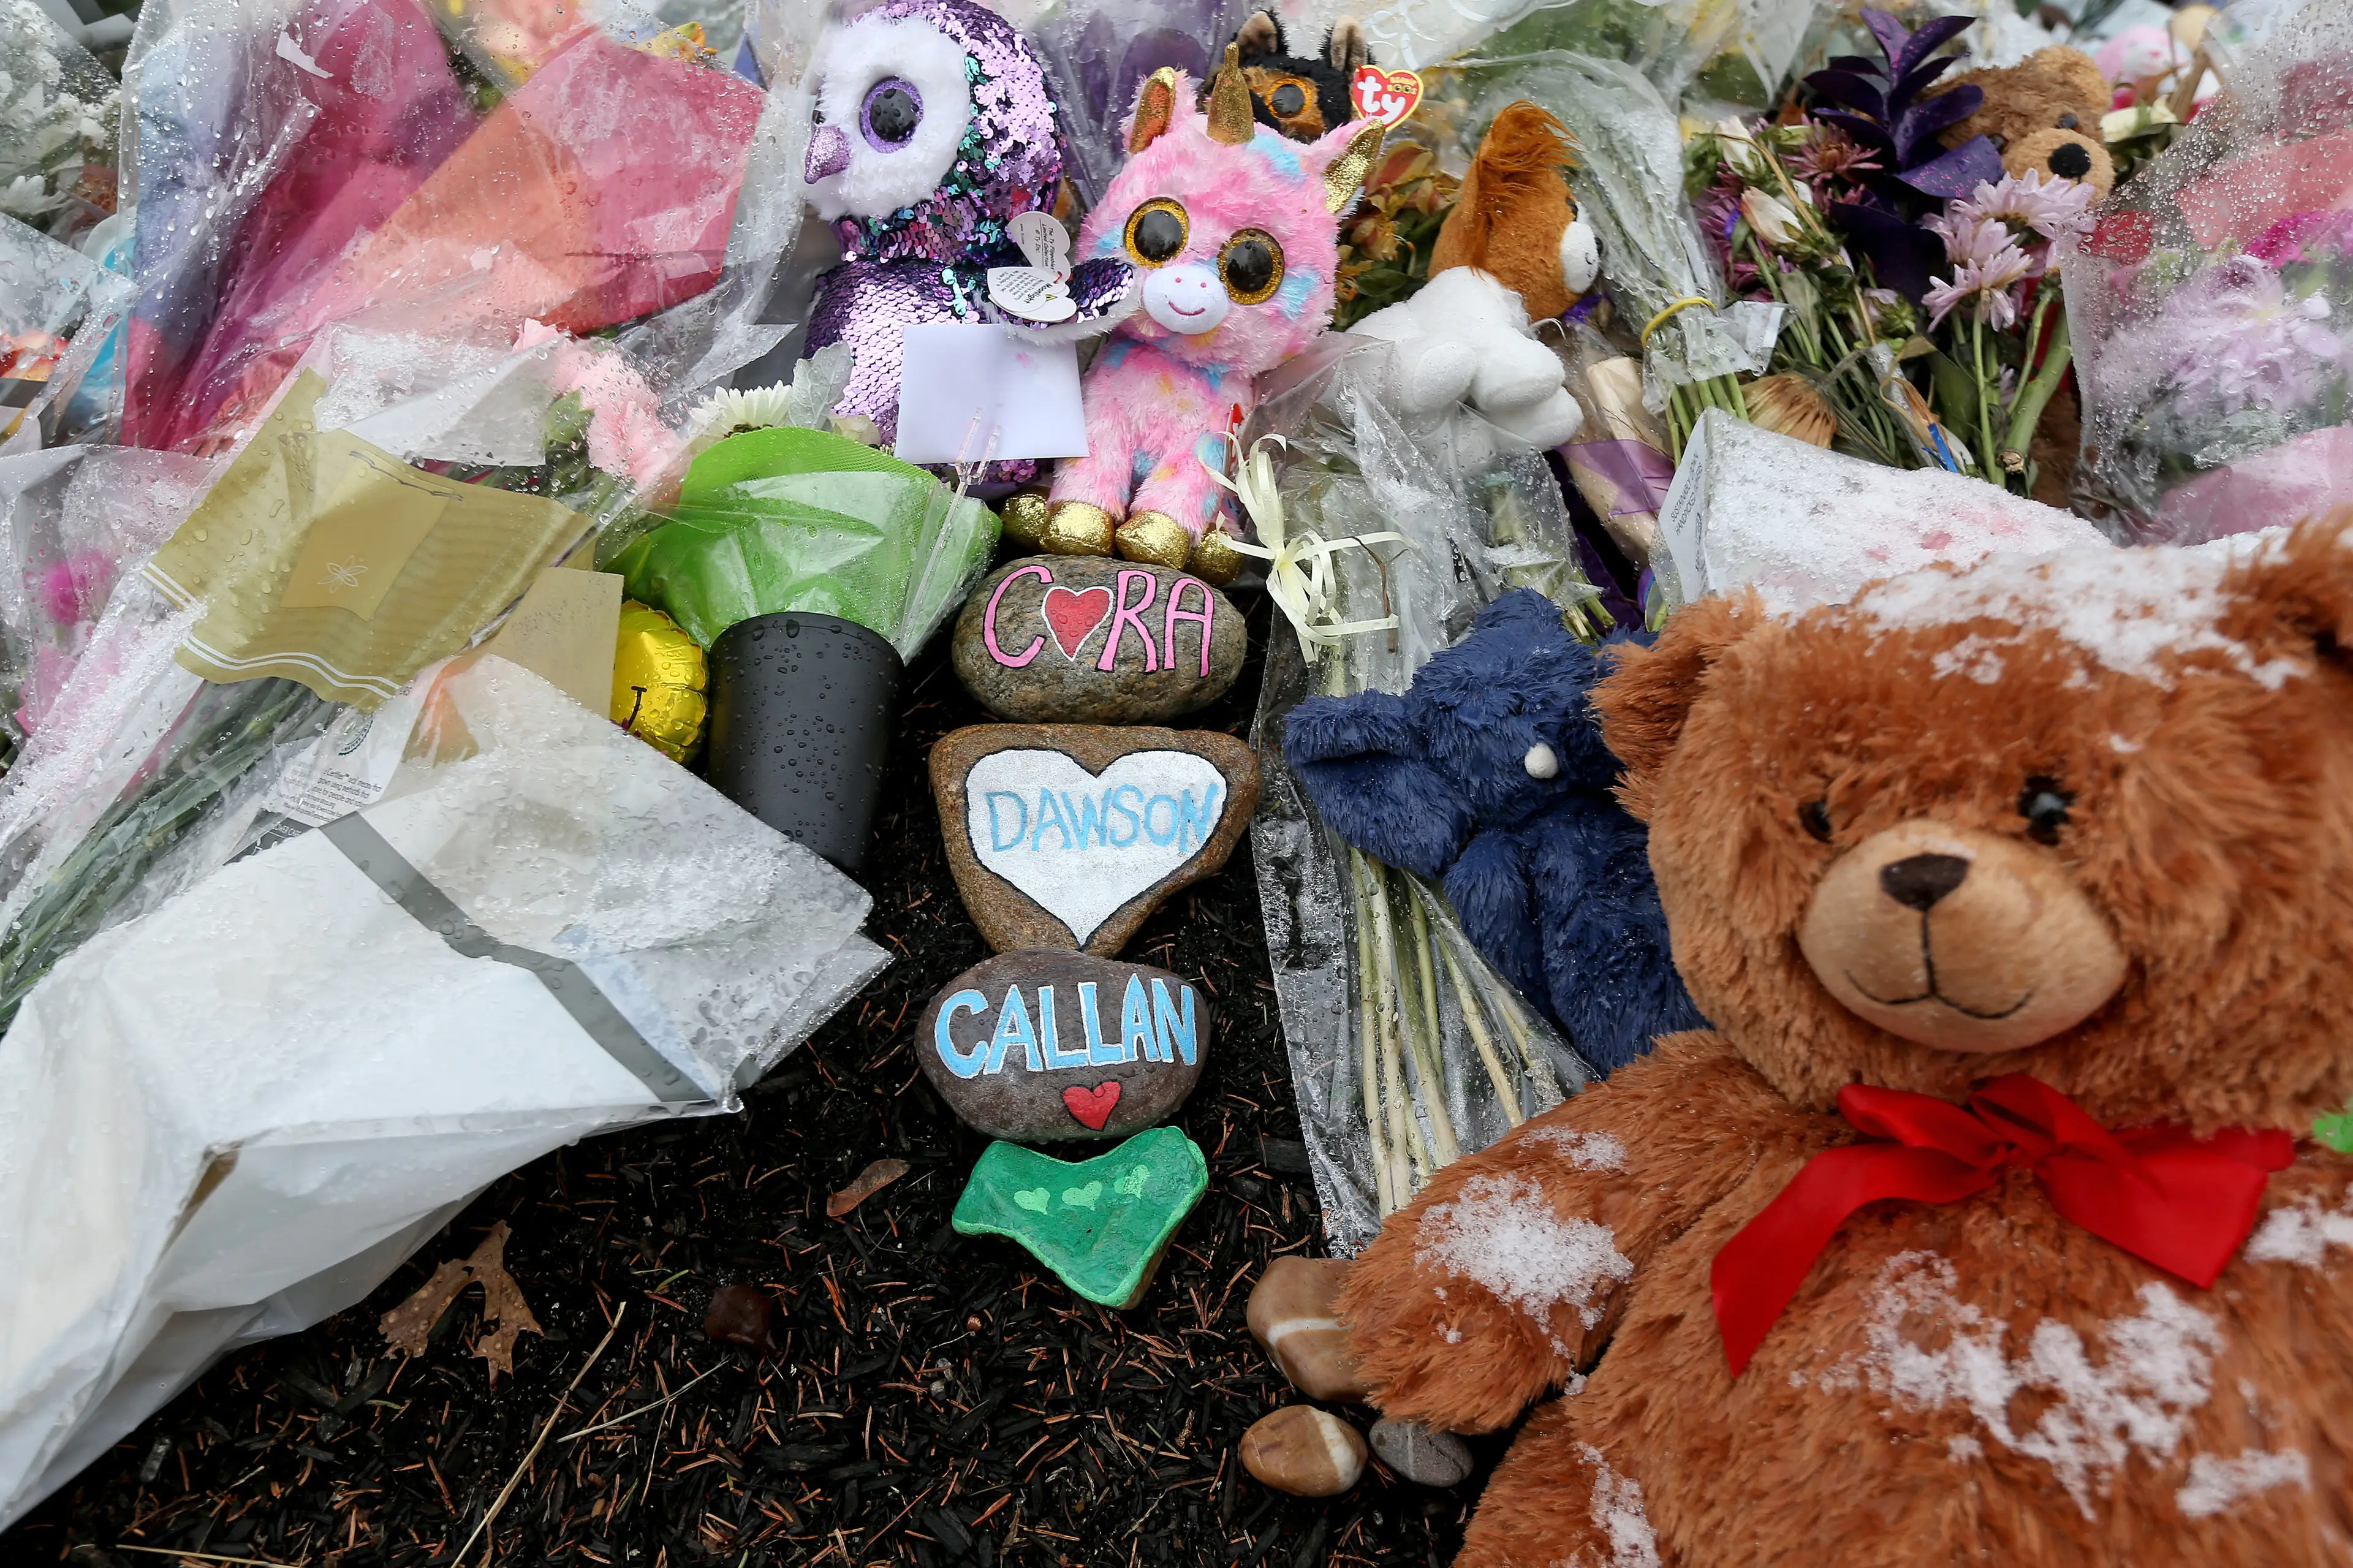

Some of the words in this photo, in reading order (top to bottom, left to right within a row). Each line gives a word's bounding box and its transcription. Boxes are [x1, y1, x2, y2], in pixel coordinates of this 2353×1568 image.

[1357, 76, 1406, 125] ty
[1024, 282, 1052, 304] Moonlight
[327, 790, 346, 802] people
[984, 782, 1219, 853] DAWSON
[934, 972, 1197, 1079] CALLAN
